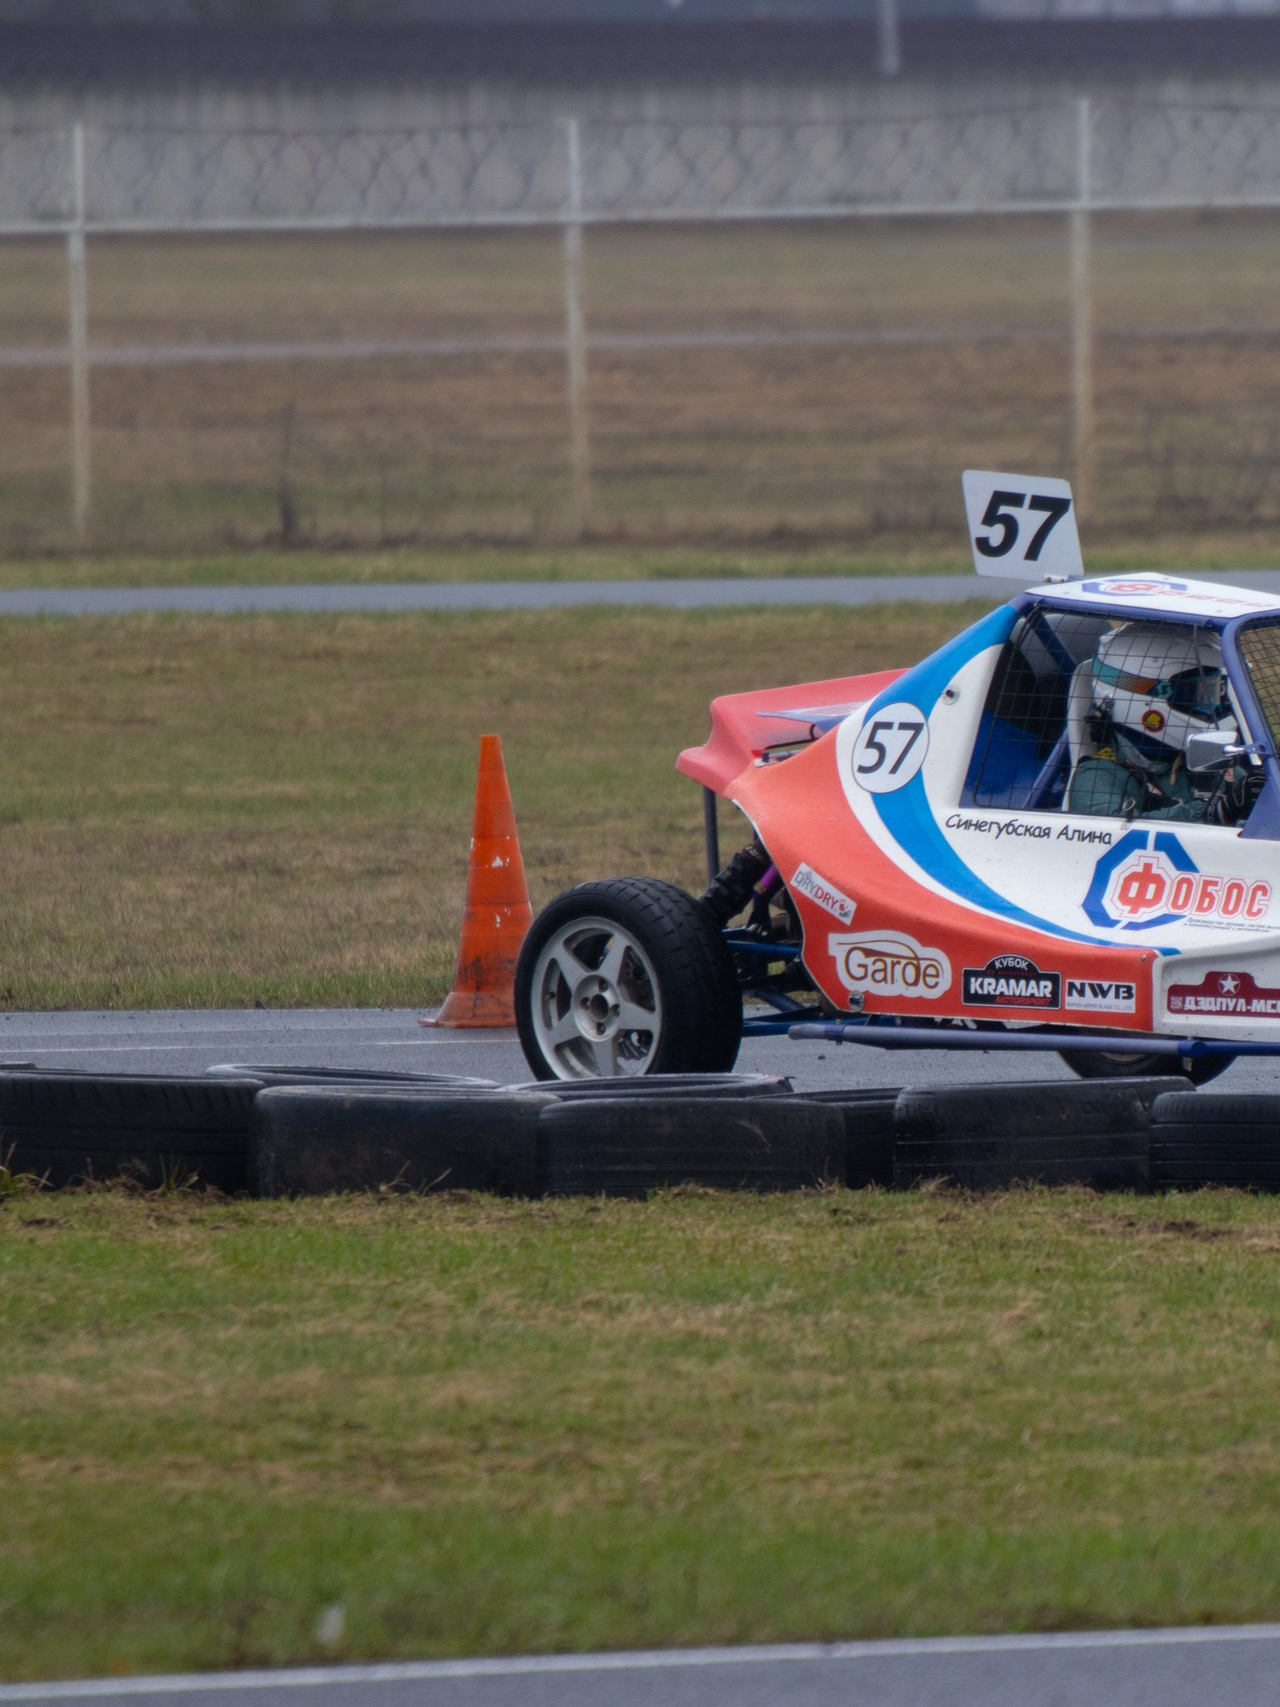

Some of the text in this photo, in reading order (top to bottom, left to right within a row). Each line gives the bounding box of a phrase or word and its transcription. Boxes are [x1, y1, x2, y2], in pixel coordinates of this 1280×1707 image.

[975, 489, 1071, 562] 57
[857, 721, 925, 775] 57
[945, 813, 1112, 845] Синегубская Алина
[1116, 861, 1271, 918] ФОБОС
[844, 946, 941, 989] Garde
[994, 957, 1029, 971] КУБОК
[970, 977, 1052, 997] KRAMAR
[995, 996, 1052, 1006] MOTORSPORT
[1067, 981, 1134, 1000] NWB
